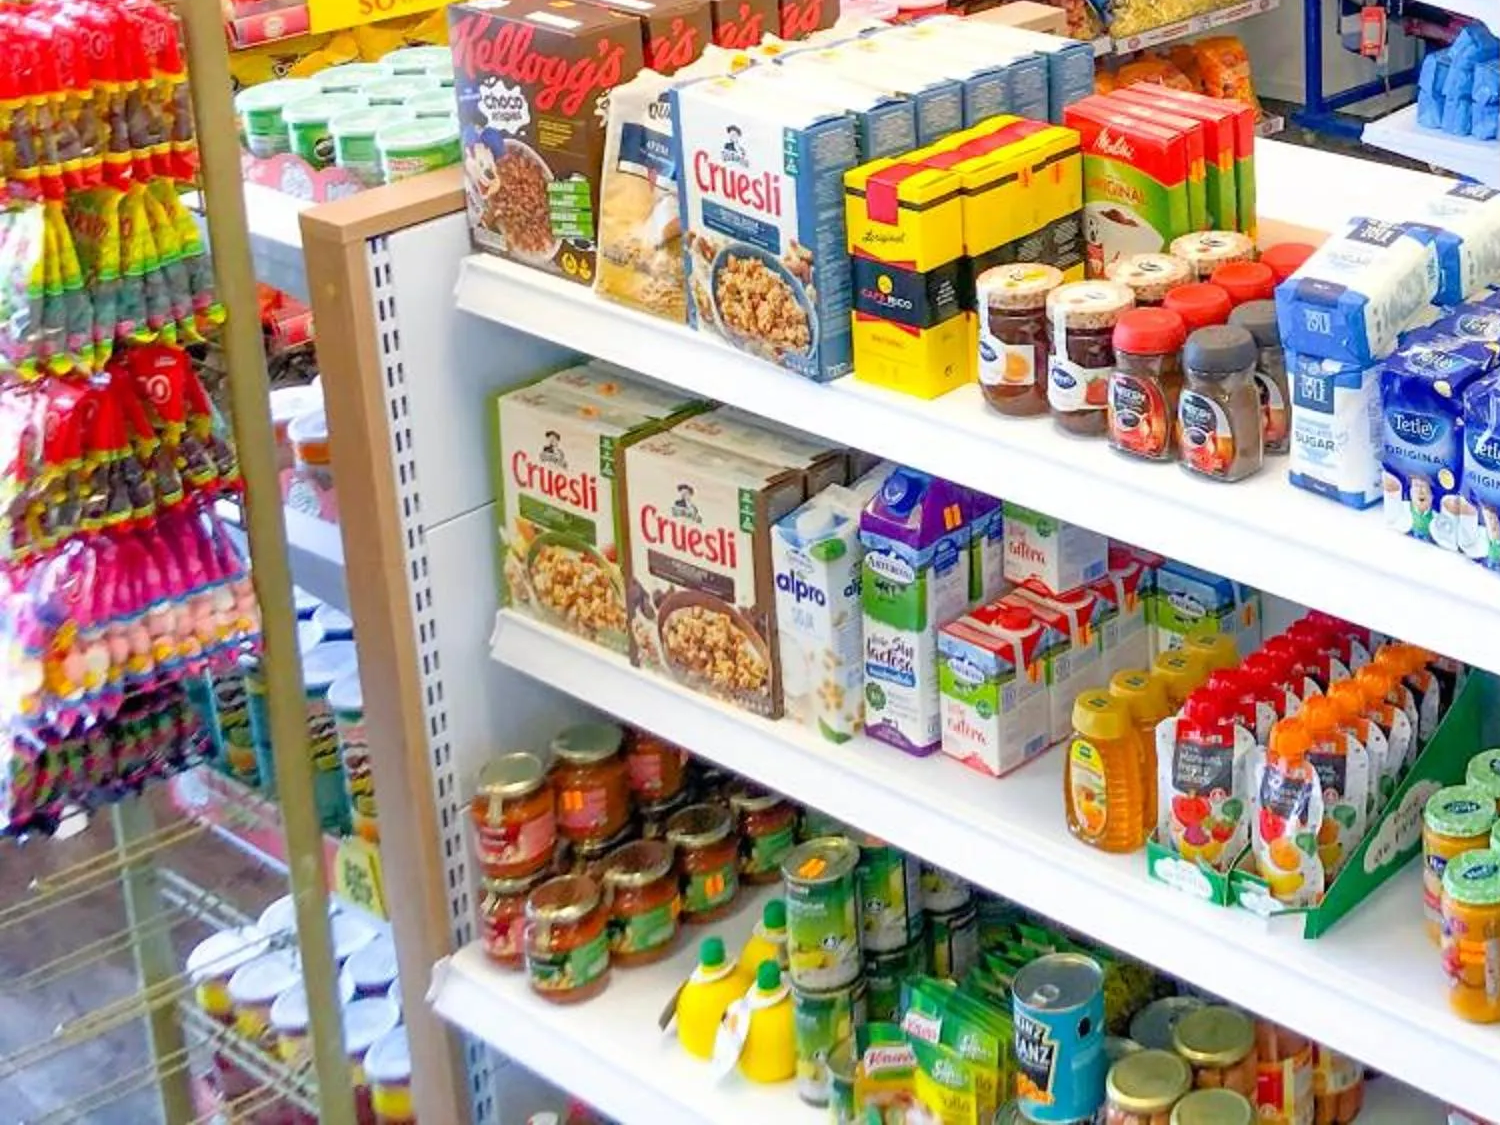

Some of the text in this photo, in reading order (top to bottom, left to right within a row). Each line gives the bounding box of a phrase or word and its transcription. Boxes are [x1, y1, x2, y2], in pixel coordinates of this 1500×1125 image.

[454, 15, 626, 117] Kellogg's
[693, 149, 782, 217] Cruesli
[1295, 430, 1336, 452] SUGAR
[1393, 412, 1438, 439] Tetley
[511, 449, 598, 513] Cruesli
[639, 504, 737, 569] Cruesli
[775, 570, 826, 607] alpro
